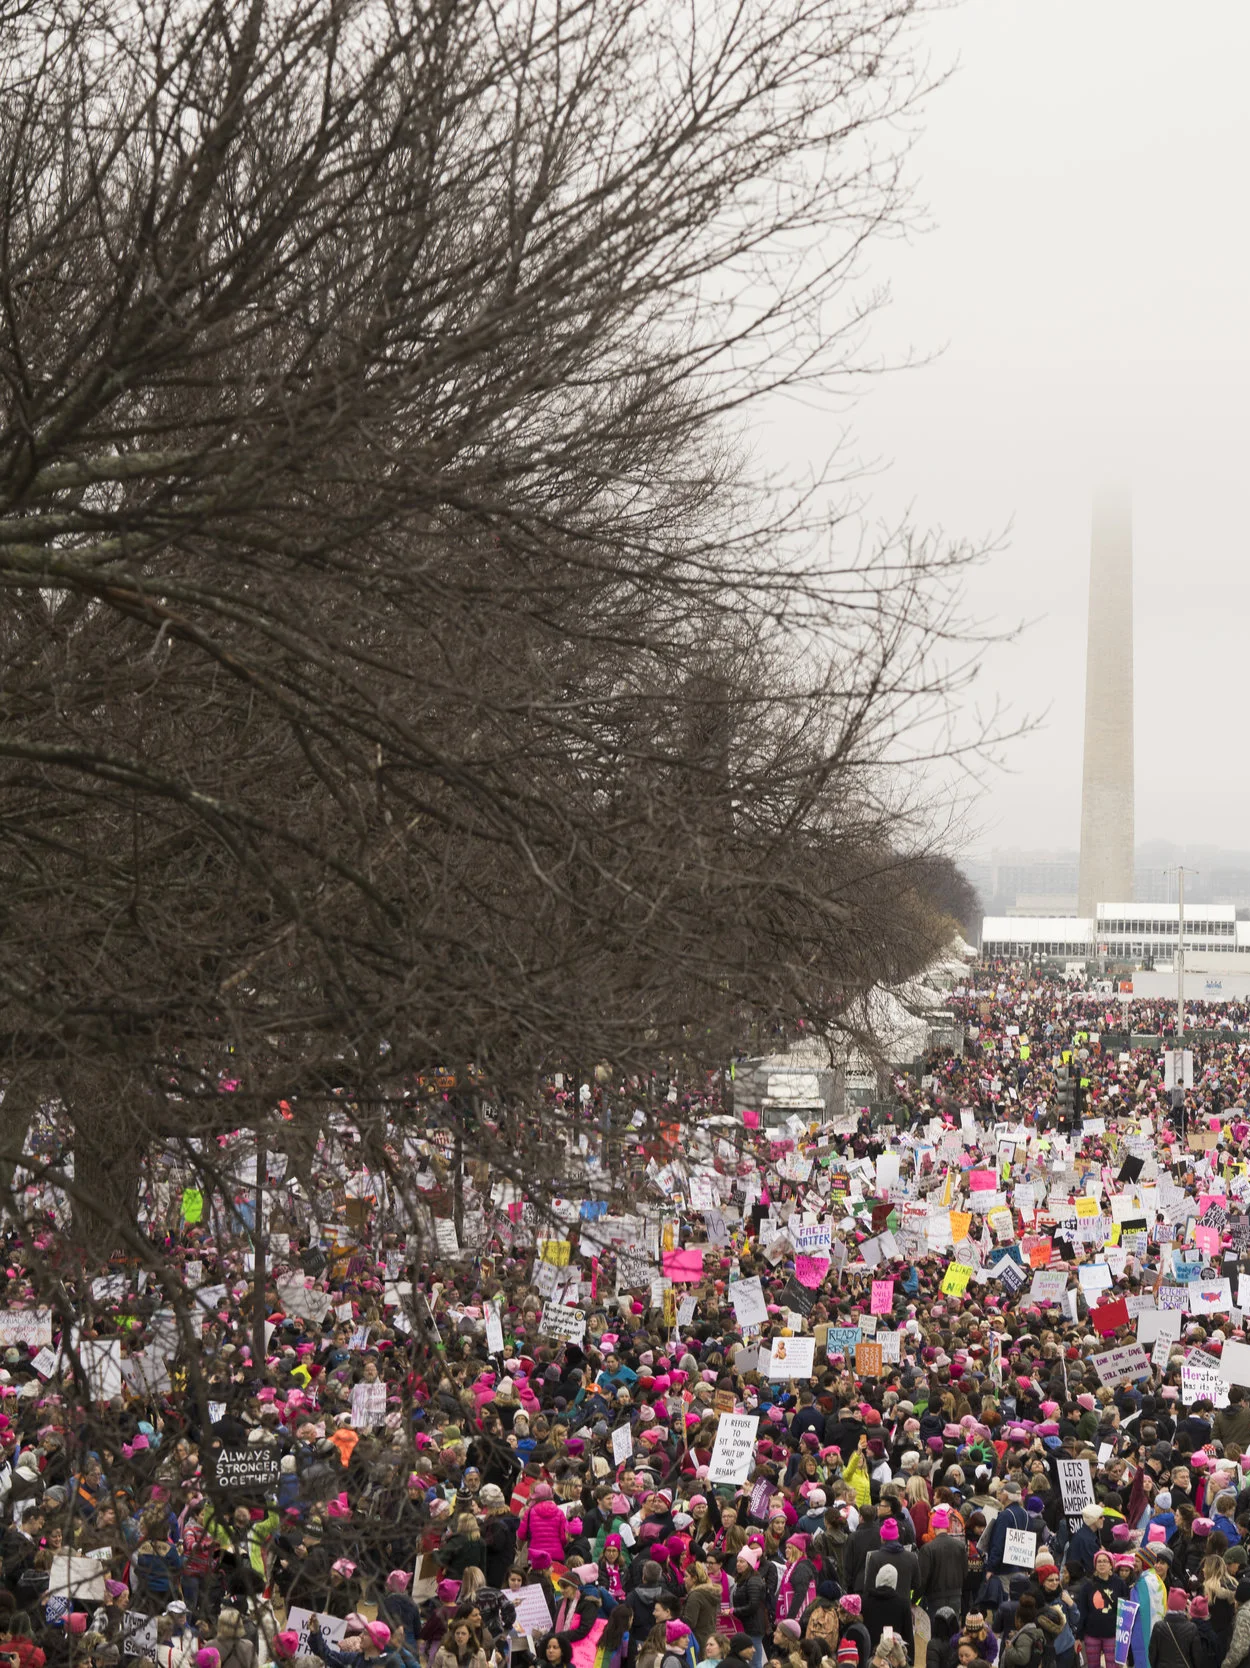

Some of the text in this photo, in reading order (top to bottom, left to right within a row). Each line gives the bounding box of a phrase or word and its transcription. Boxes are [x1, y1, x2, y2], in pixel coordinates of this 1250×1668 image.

[800, 1224, 831, 1237] FACTS
[796, 1233, 831, 1249] MATTER
[1005, 1267, 1021, 1288] TRUST
[828, 1329, 859, 1342] READY
[1128, 1346, 1143, 1356] LOVE
[1194, 1349, 1205, 1359] Our
[1102, 1370, 1118, 1381] STILL
[1133, 1361, 1149, 1372] HATE
[1184, 1382, 1196, 1390] has
[1199, 1382, 1210, 1390] its
[731, 1420, 751, 1430] REFUSE
[733, 1430, 742, 1438] TO
[719, 1438, 751, 1449] SIT DOWN
[219, 1449, 271, 1465] ALWAYS
[721, 1447, 745, 1456] SHUT UP
[726, 1458, 735, 1467] OR
[215, 1463, 279, 1478] STRONGER
[715, 1468, 737, 1478] BEHAVE
[1064, 1463, 1083, 1477] LET'S
[1066, 1481, 1086, 1495] MAKE
[1009, 1529, 1026, 1544] SAVE
